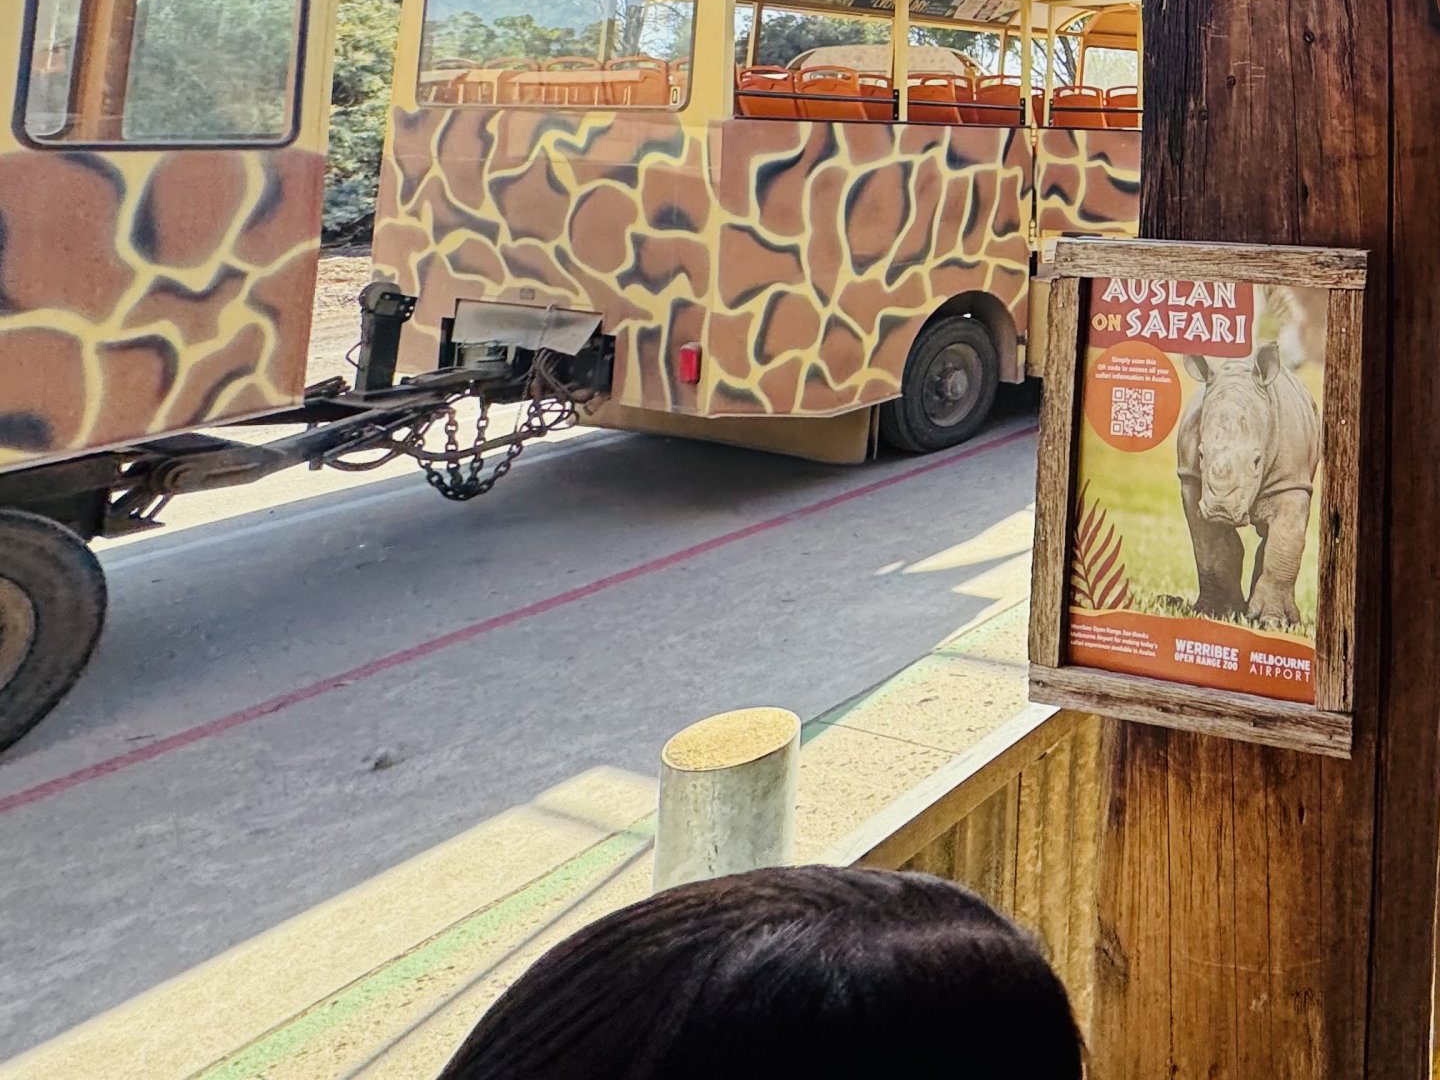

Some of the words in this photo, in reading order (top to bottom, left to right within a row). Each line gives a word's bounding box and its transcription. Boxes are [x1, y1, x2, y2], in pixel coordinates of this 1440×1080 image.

[1102, 277, 1236, 309] AUSLAN
[1091, 313, 1121, 331] ON
[1125, 308, 1246, 344] SAFARI
[1097, 363, 1106, 371] QR
[1145, 357, 1157, 365] this
[1111, 373, 1145, 381] information
[1175, 639, 1239, 661] WERRIBEE
[1174, 652, 1194, 663] OPEN
[1195, 654, 1221, 668] RANGE
[1222, 661, 1238, 671] ZOO
[1249, 651, 1311, 671] MELBOURNE
[1249, 664, 1311, 683] AIRPORT
